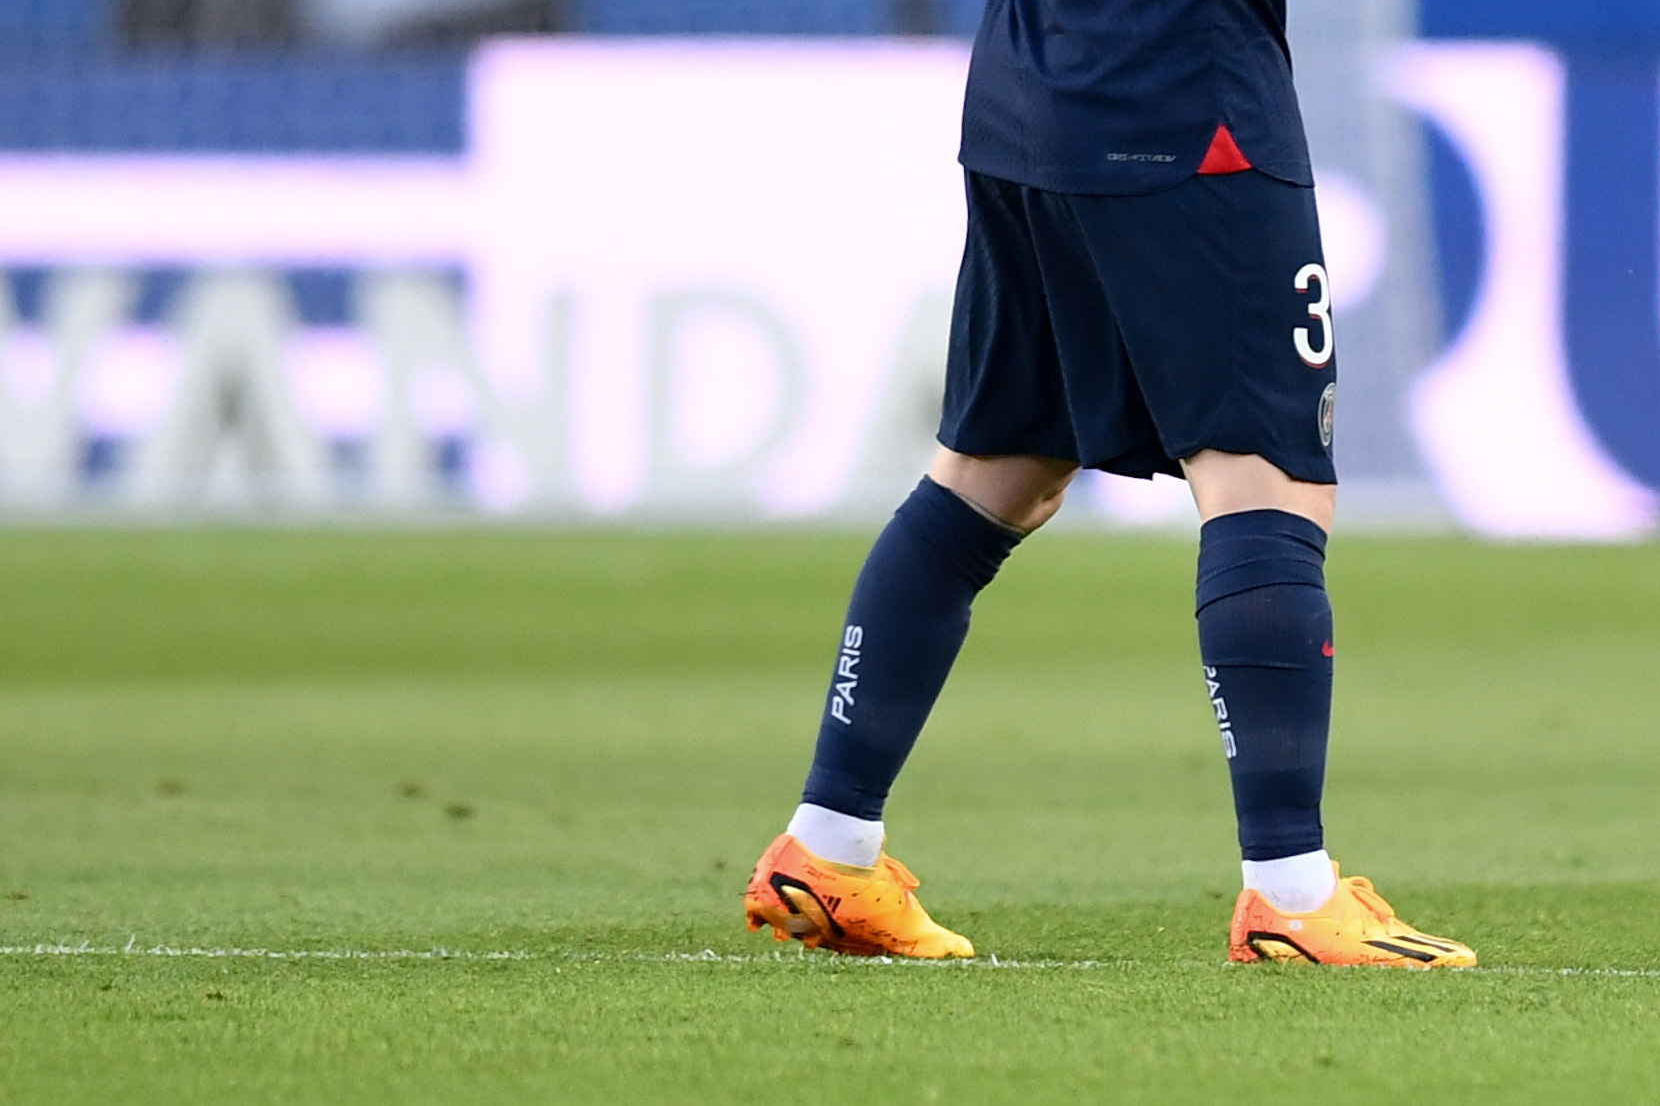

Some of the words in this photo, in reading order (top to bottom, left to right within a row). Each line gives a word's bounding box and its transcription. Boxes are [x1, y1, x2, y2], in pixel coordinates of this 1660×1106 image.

[1293, 263, 1333, 369] 3
[831, 625, 863, 725] PARIS
[1202, 665, 1237, 760] PARIS
